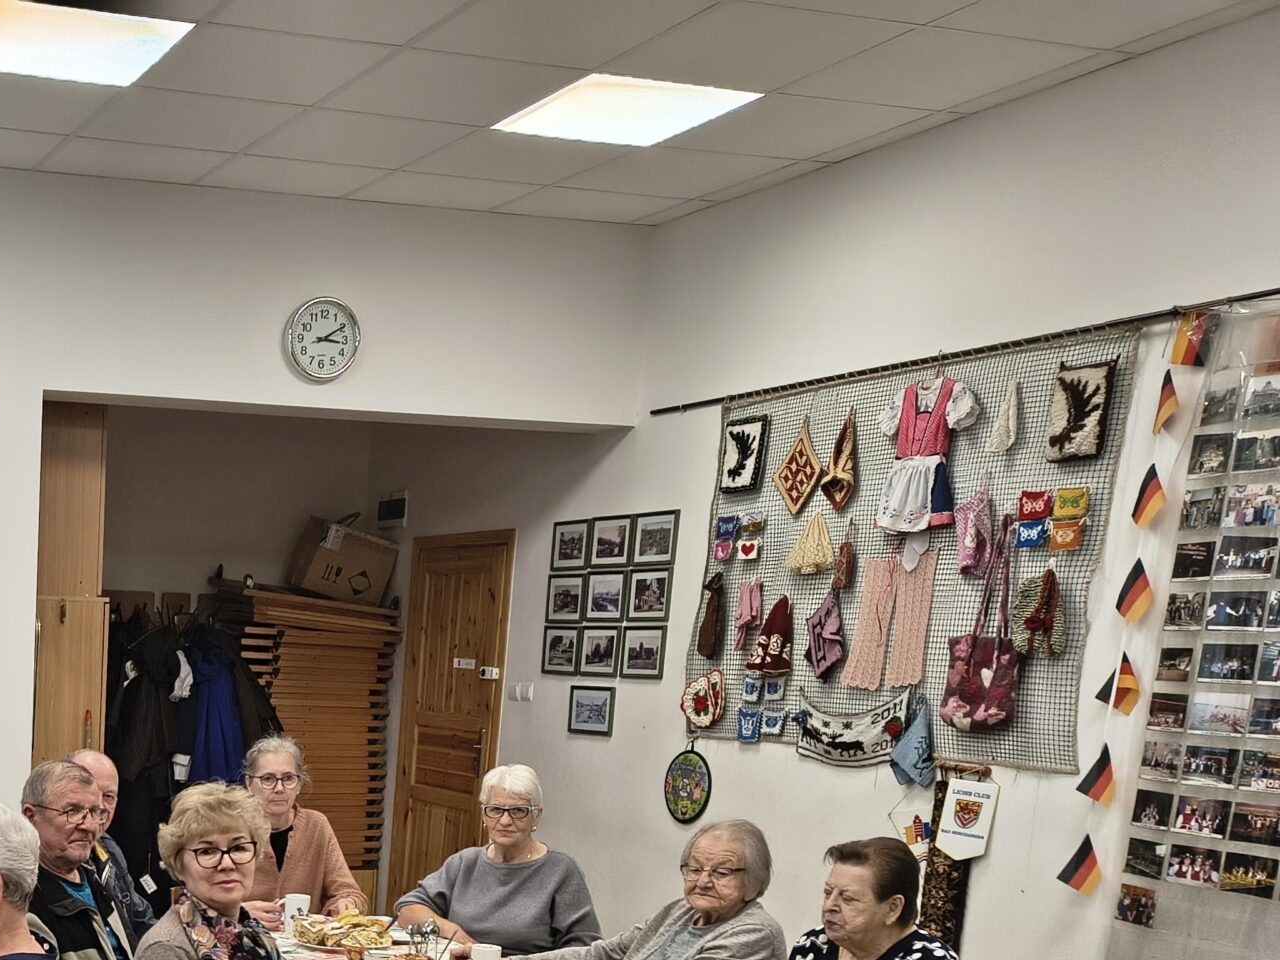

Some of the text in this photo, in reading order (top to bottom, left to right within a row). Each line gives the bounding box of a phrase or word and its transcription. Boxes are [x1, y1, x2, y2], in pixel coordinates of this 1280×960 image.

[309, 312, 318, 322] 11
[320, 309, 330, 320] 12
[333, 313, 338, 323] 1
[301, 322, 312, 333] 10
[339, 323, 346, 333] 2
[297, 333, 304, 343] 9
[341, 335, 348, 345] 3
[300, 346, 307, 356] 8
[338, 348, 345, 357] 4
[309, 356, 315, 365] 7
[318, 359, 325, 369] 6
[329, 356, 336, 366] 5
[871, 739, 894, 754] 201
